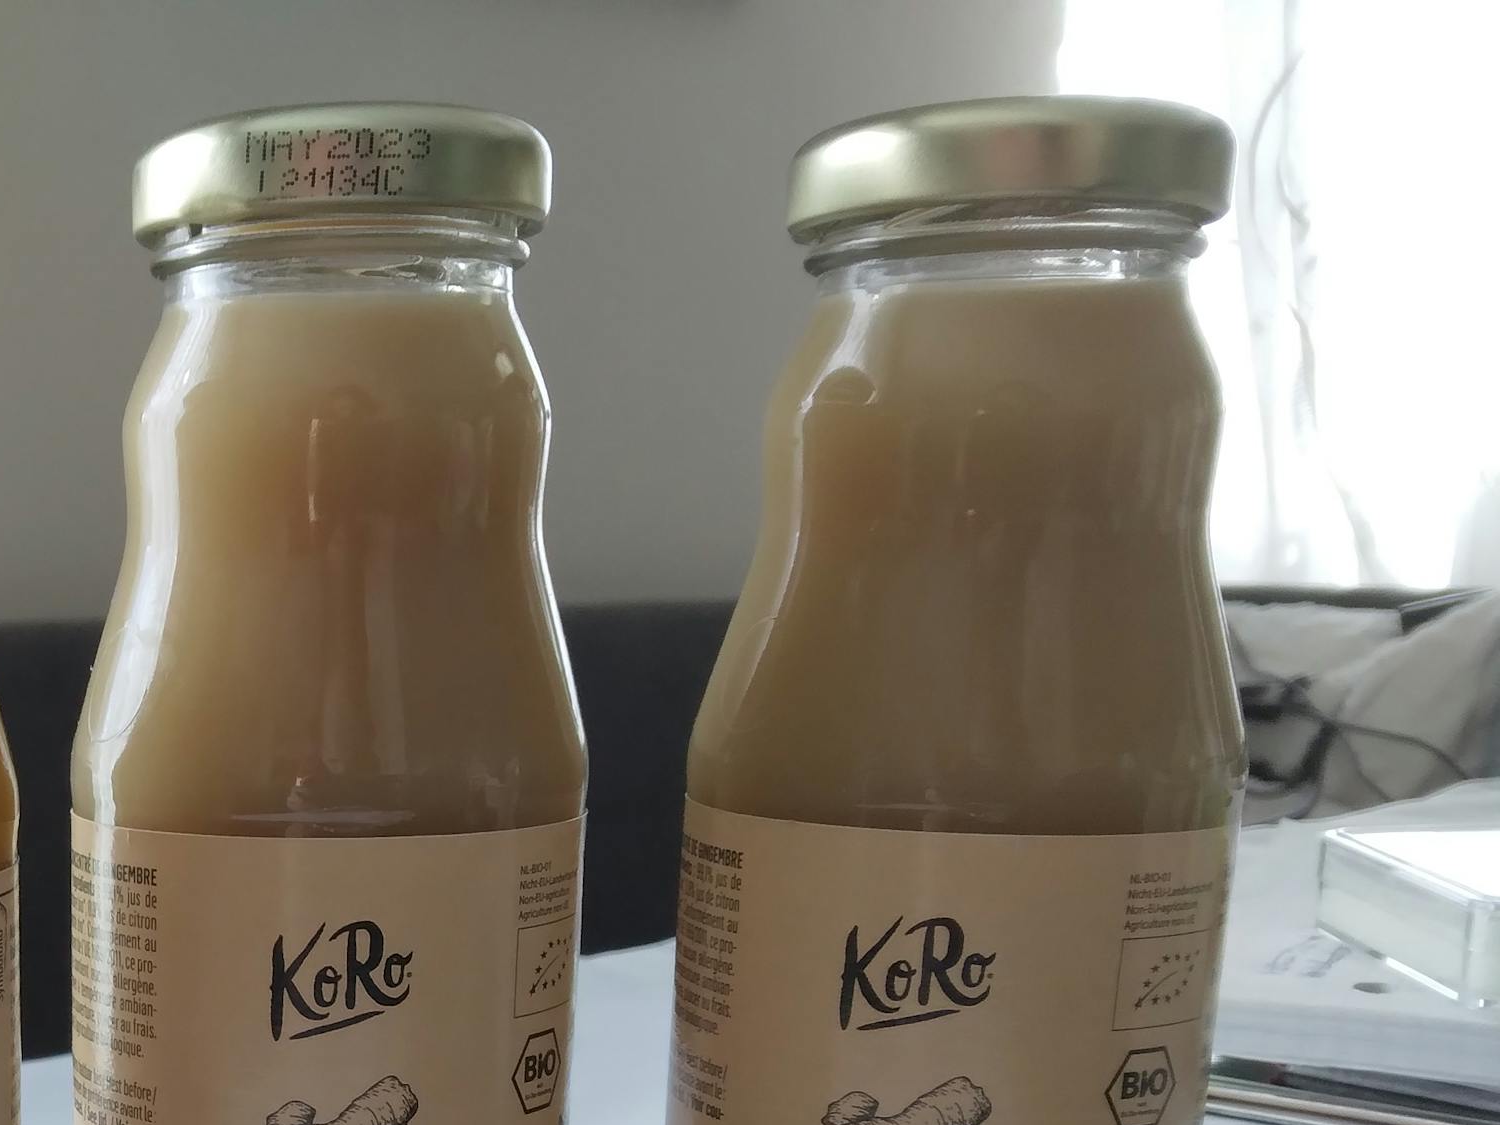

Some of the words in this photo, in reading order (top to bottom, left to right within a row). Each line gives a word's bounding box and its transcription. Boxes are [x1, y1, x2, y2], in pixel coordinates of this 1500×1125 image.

[145, 891, 157, 909] de
[129, 911, 157, 931] citron
[145, 938, 157, 952] au
[269, 920, 414, 1042] KoRo
[839, 915, 996, 1030] KoRo
